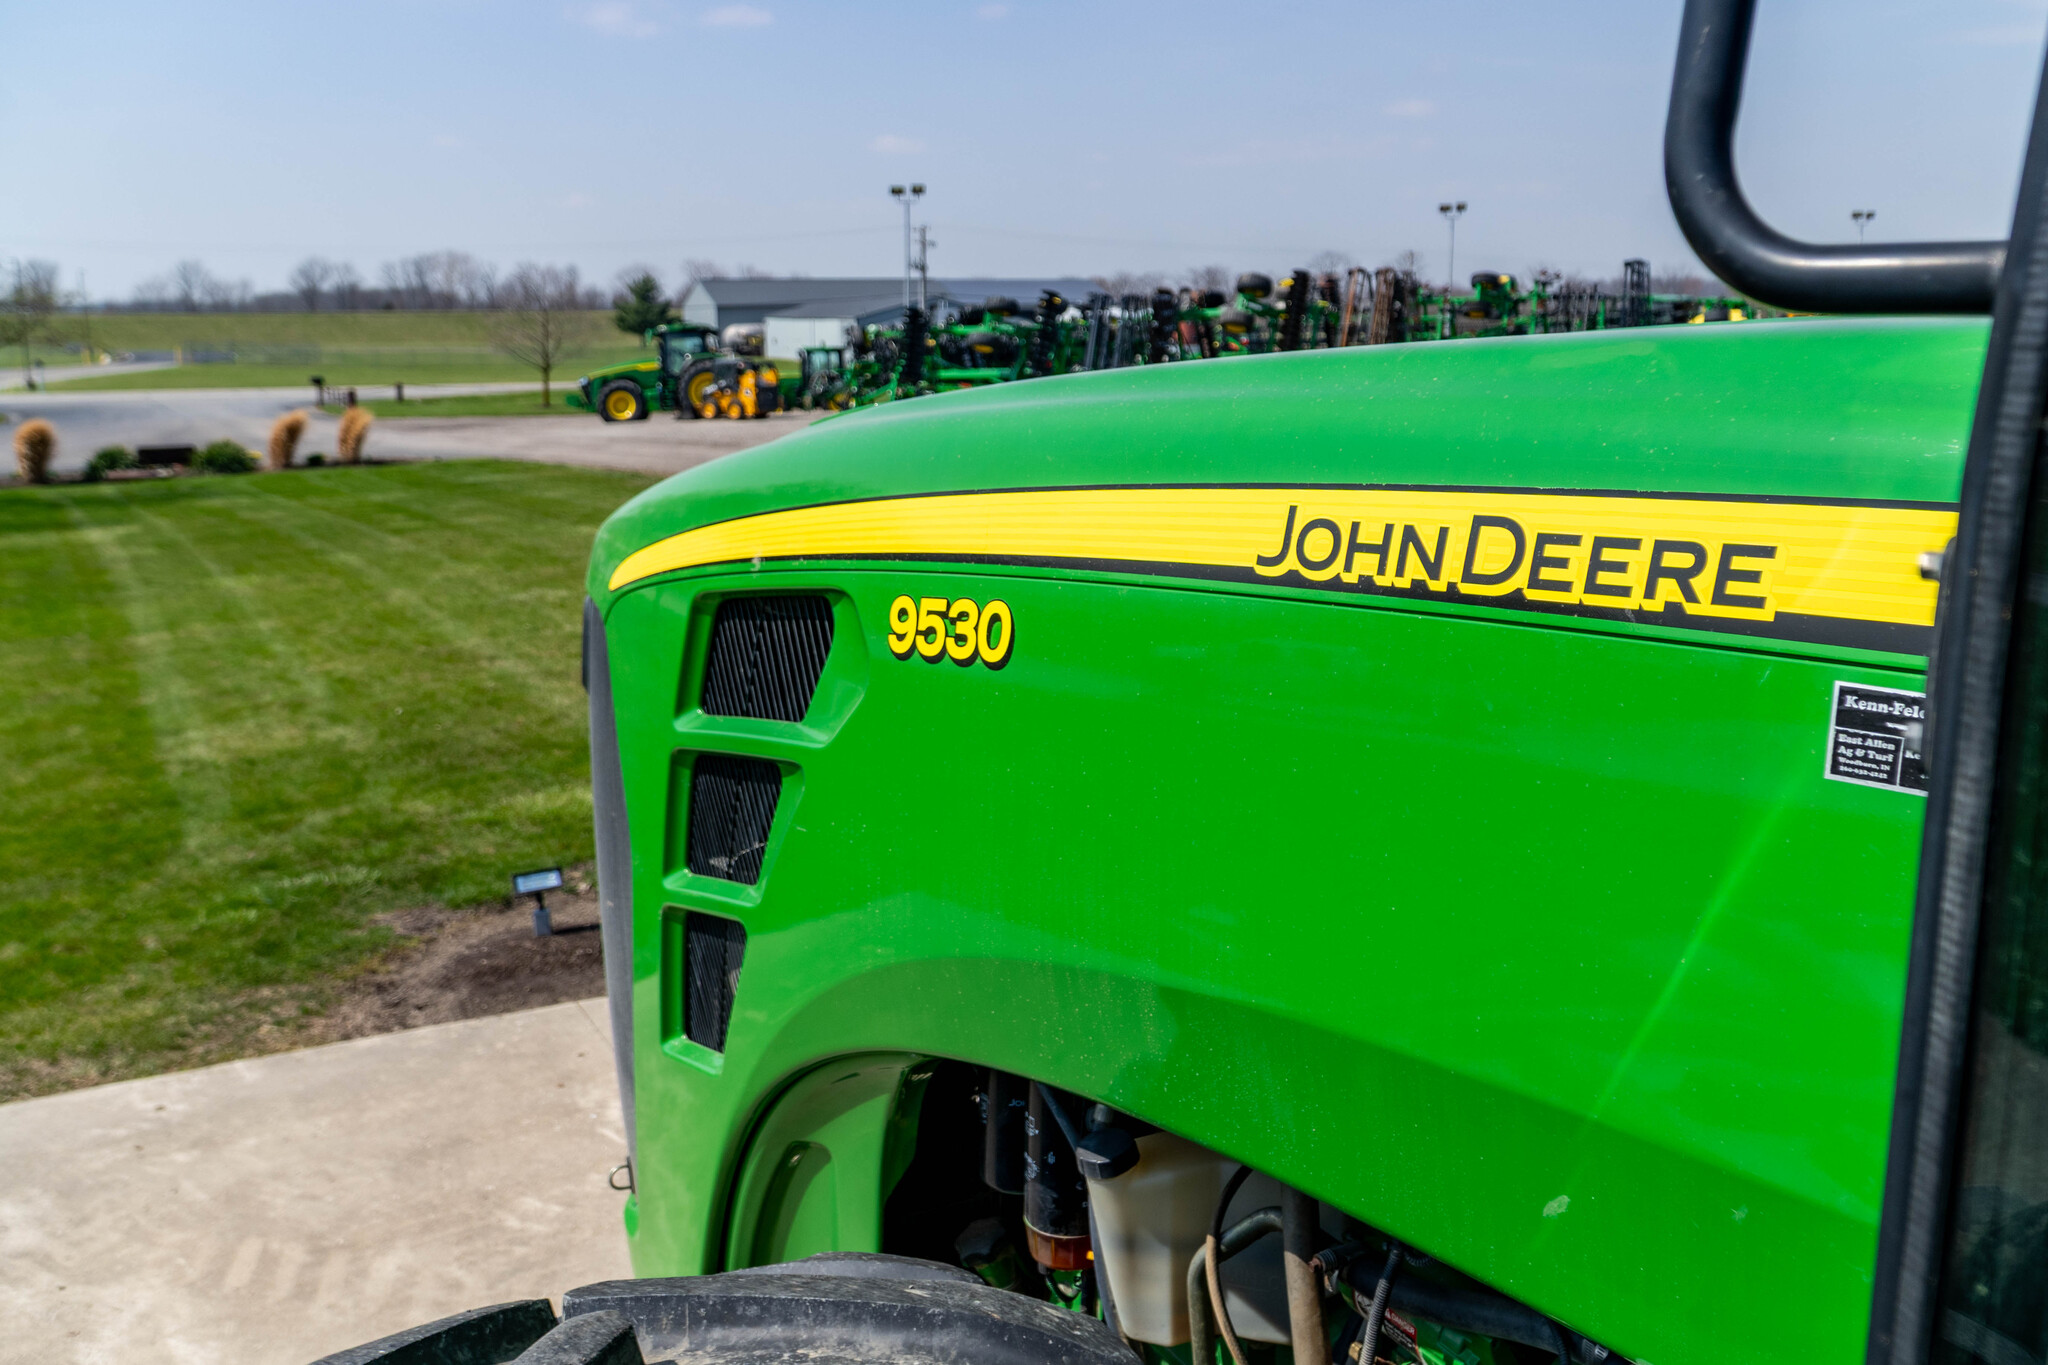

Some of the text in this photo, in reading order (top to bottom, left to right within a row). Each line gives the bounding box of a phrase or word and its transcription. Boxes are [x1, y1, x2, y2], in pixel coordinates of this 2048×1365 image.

[1255, 505, 1780, 613] JOHN DEERE
[888, 594, 1014, 669] 9530
[1837, 733, 1896, 750] East Allen
[1837, 745, 1895, 762] Ag & Turf
[1838, 756, 1880, 770] Woodburn,
